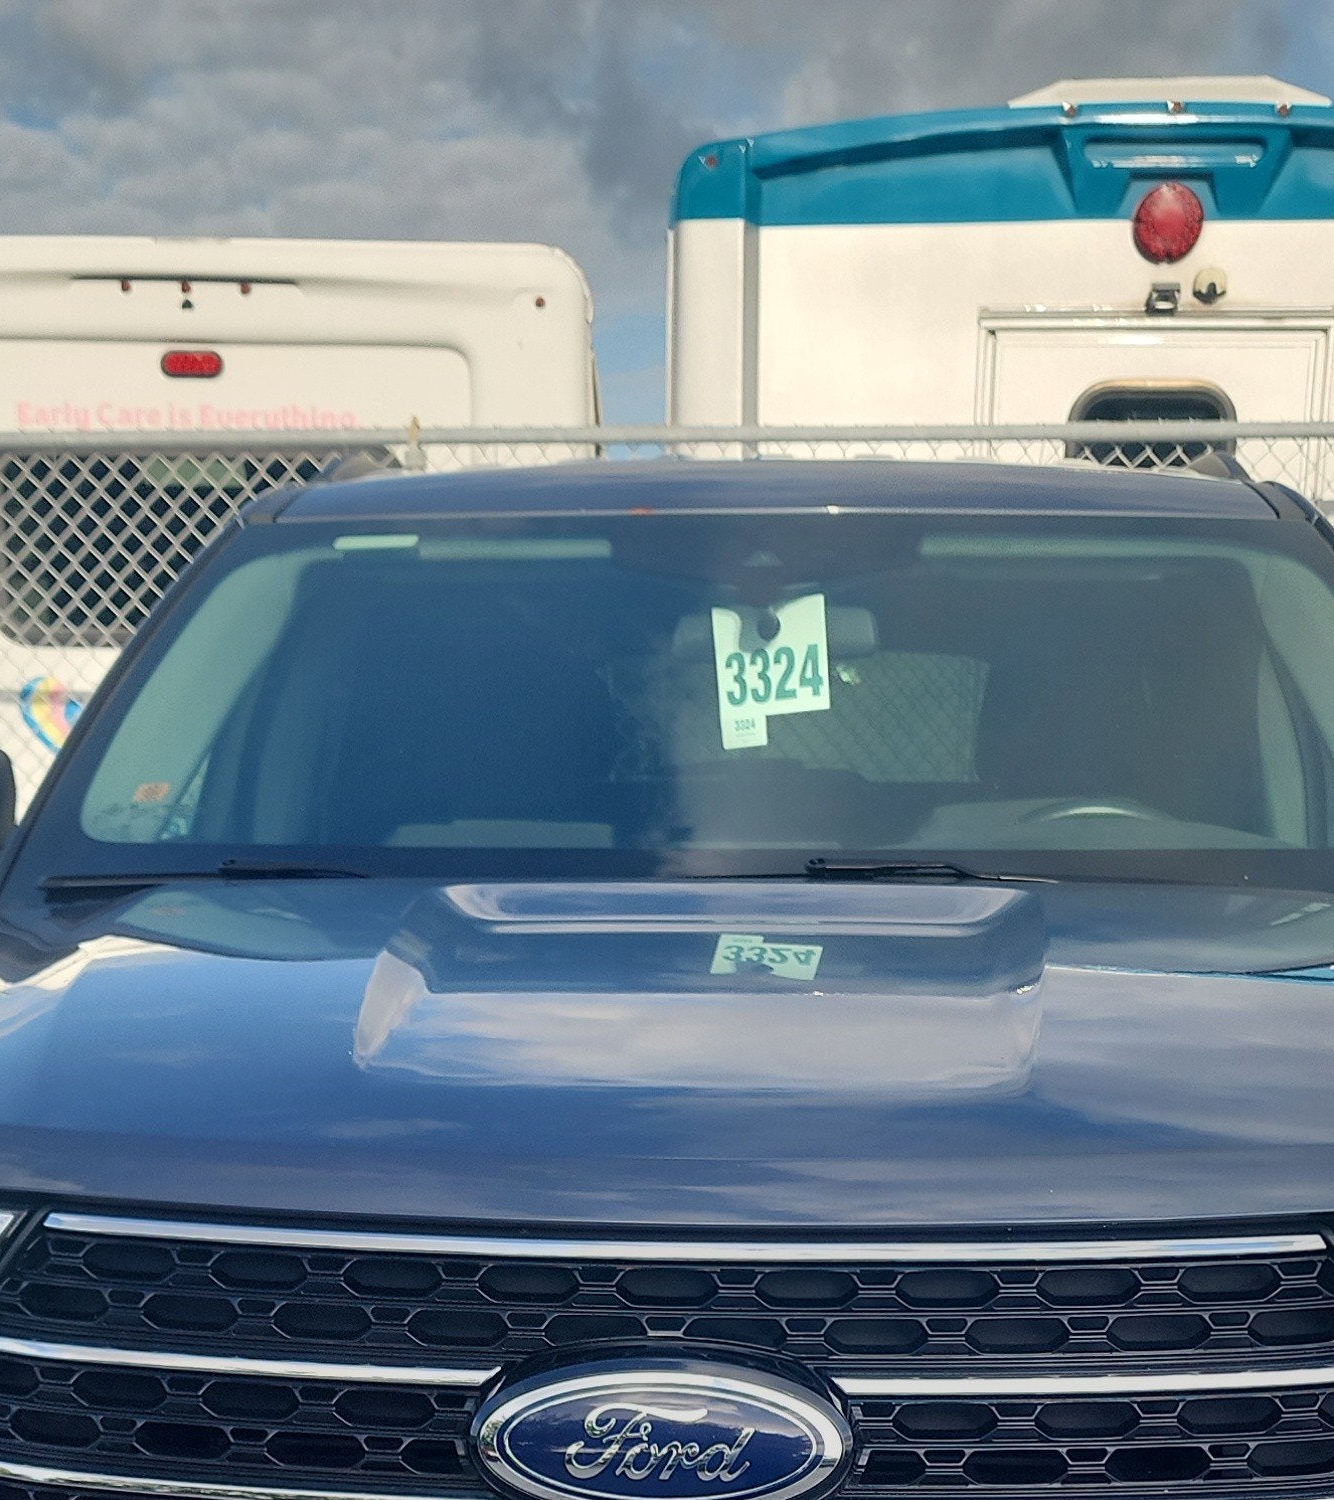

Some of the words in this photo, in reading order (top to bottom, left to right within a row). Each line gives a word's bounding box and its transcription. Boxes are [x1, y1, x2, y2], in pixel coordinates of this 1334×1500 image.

[17, 400, 91, 431] Early
[97, 401, 162, 428] Care
[169, 401, 193, 428] is
[725, 644, 823, 706] 3324
[734, 718, 755, 731] 3324
[565, 1402, 755, 1482] Ford
